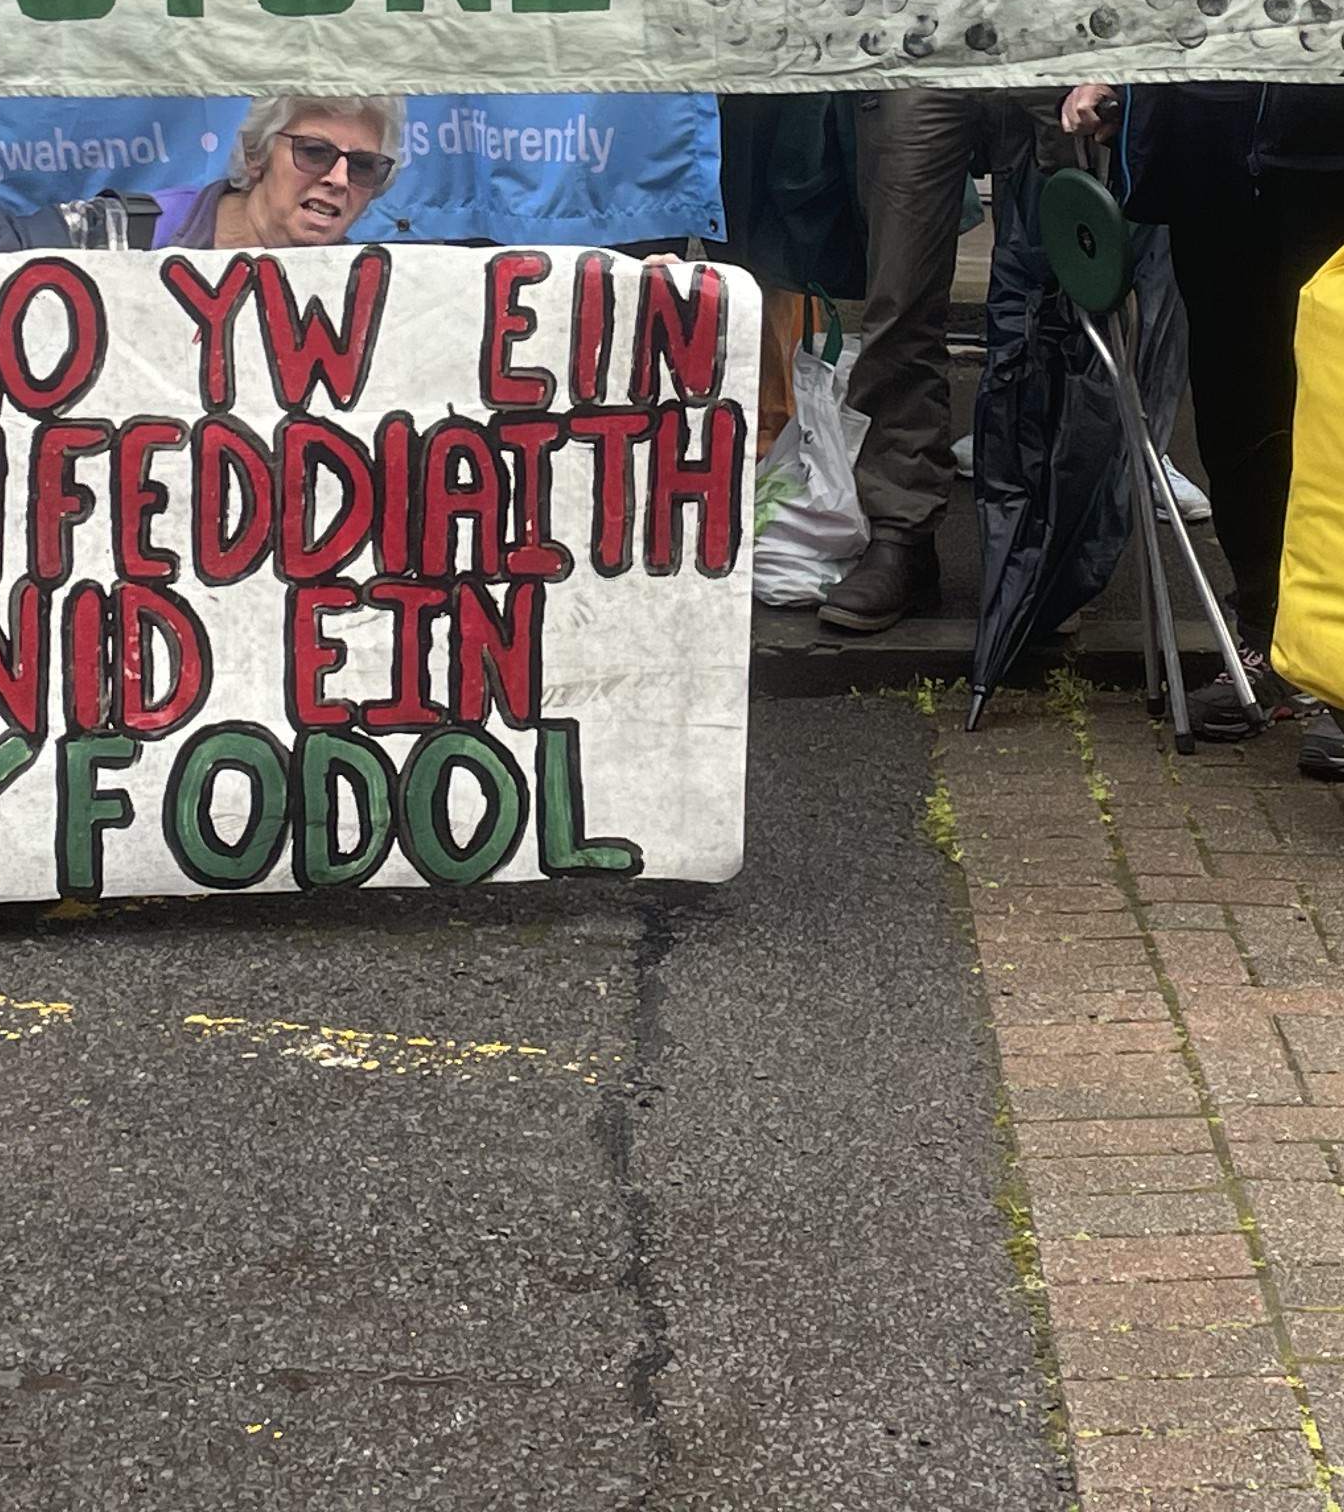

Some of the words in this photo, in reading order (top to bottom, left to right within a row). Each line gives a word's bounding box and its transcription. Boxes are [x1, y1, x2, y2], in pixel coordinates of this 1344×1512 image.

[438, 108, 616, 174] differently
[159, 244, 392, 413] YW
[480, 249, 728, 409] EIN
[284, 576, 545, 733] EIN
